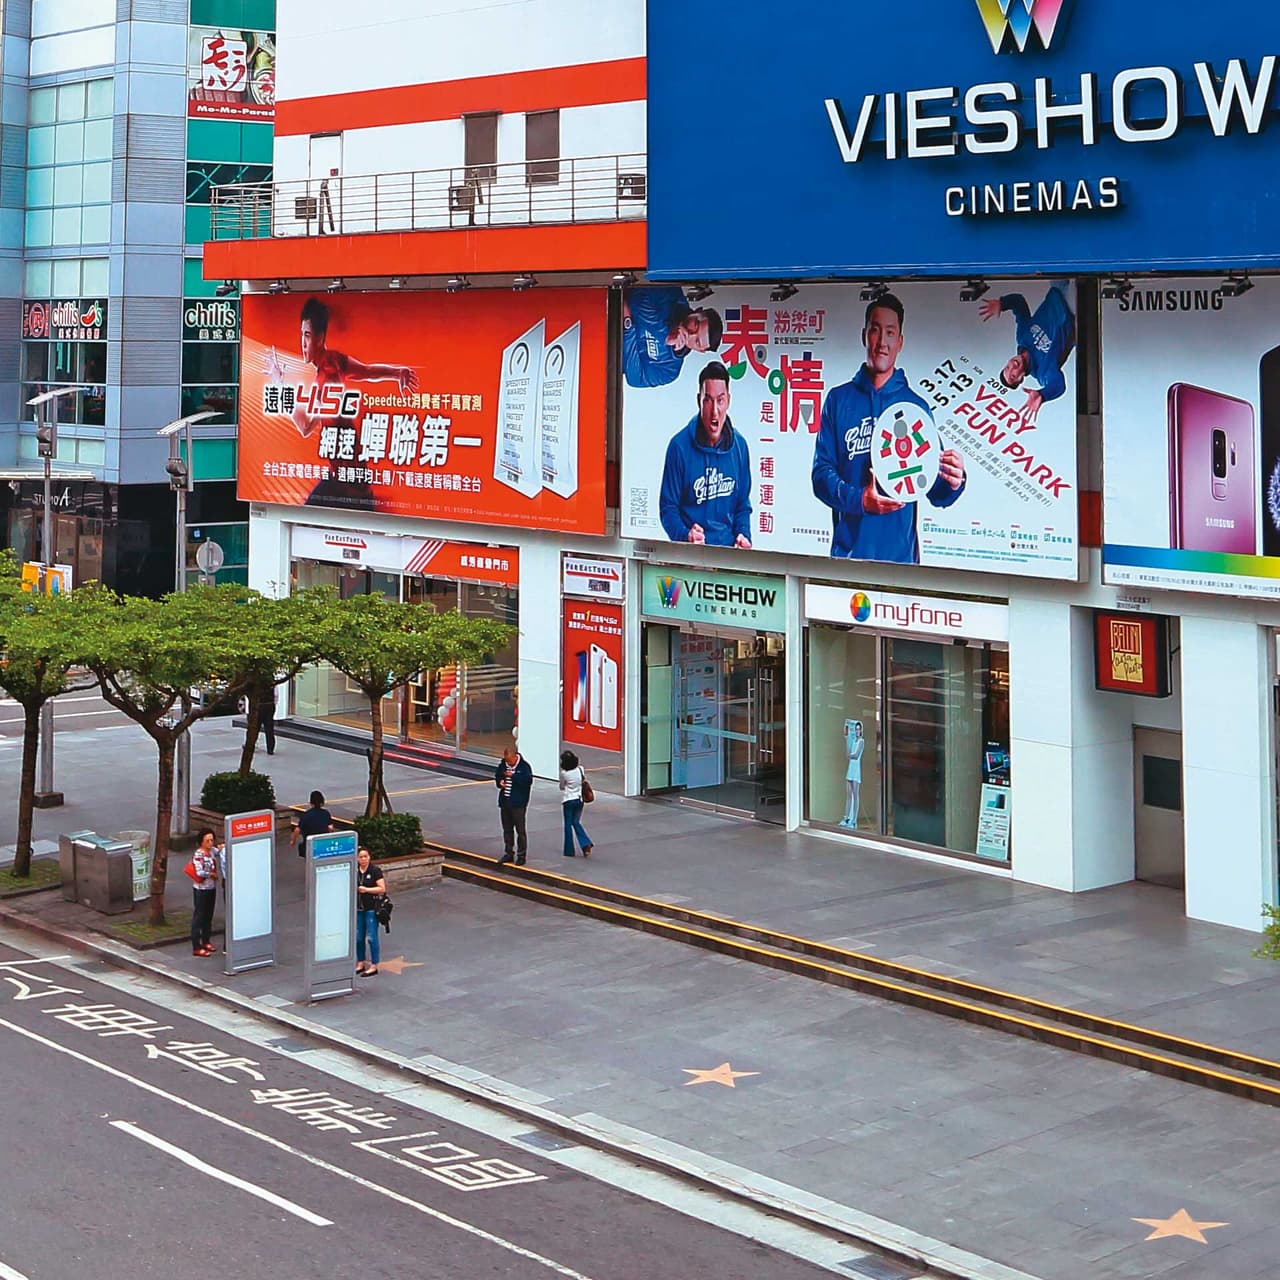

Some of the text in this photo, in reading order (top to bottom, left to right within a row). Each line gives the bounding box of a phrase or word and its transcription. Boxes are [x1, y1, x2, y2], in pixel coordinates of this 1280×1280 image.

[825, 56, 1280, 162] VIESHOW
[945, 177, 1119, 216] CINEMAS
[1119, 289, 1223, 311] SAMSUNG
[185, 301, 235, 328] chili's
[774, 310, 826, 333] 粉樂町
[920, 359, 957, 393] 3.17
[986, 377, 1008, 395] 2018
[975, 384, 1036, 435] VERY
[953, 402, 1006, 445] FUN
[759, 401, 775, 534] 是一種運動
[1205, 517, 1235, 529] SAMSUNG
[684, 580, 776, 608] VIESHOW
[695, 603, 758, 619] CINEMAS
[874, 602, 963, 627] myfone
